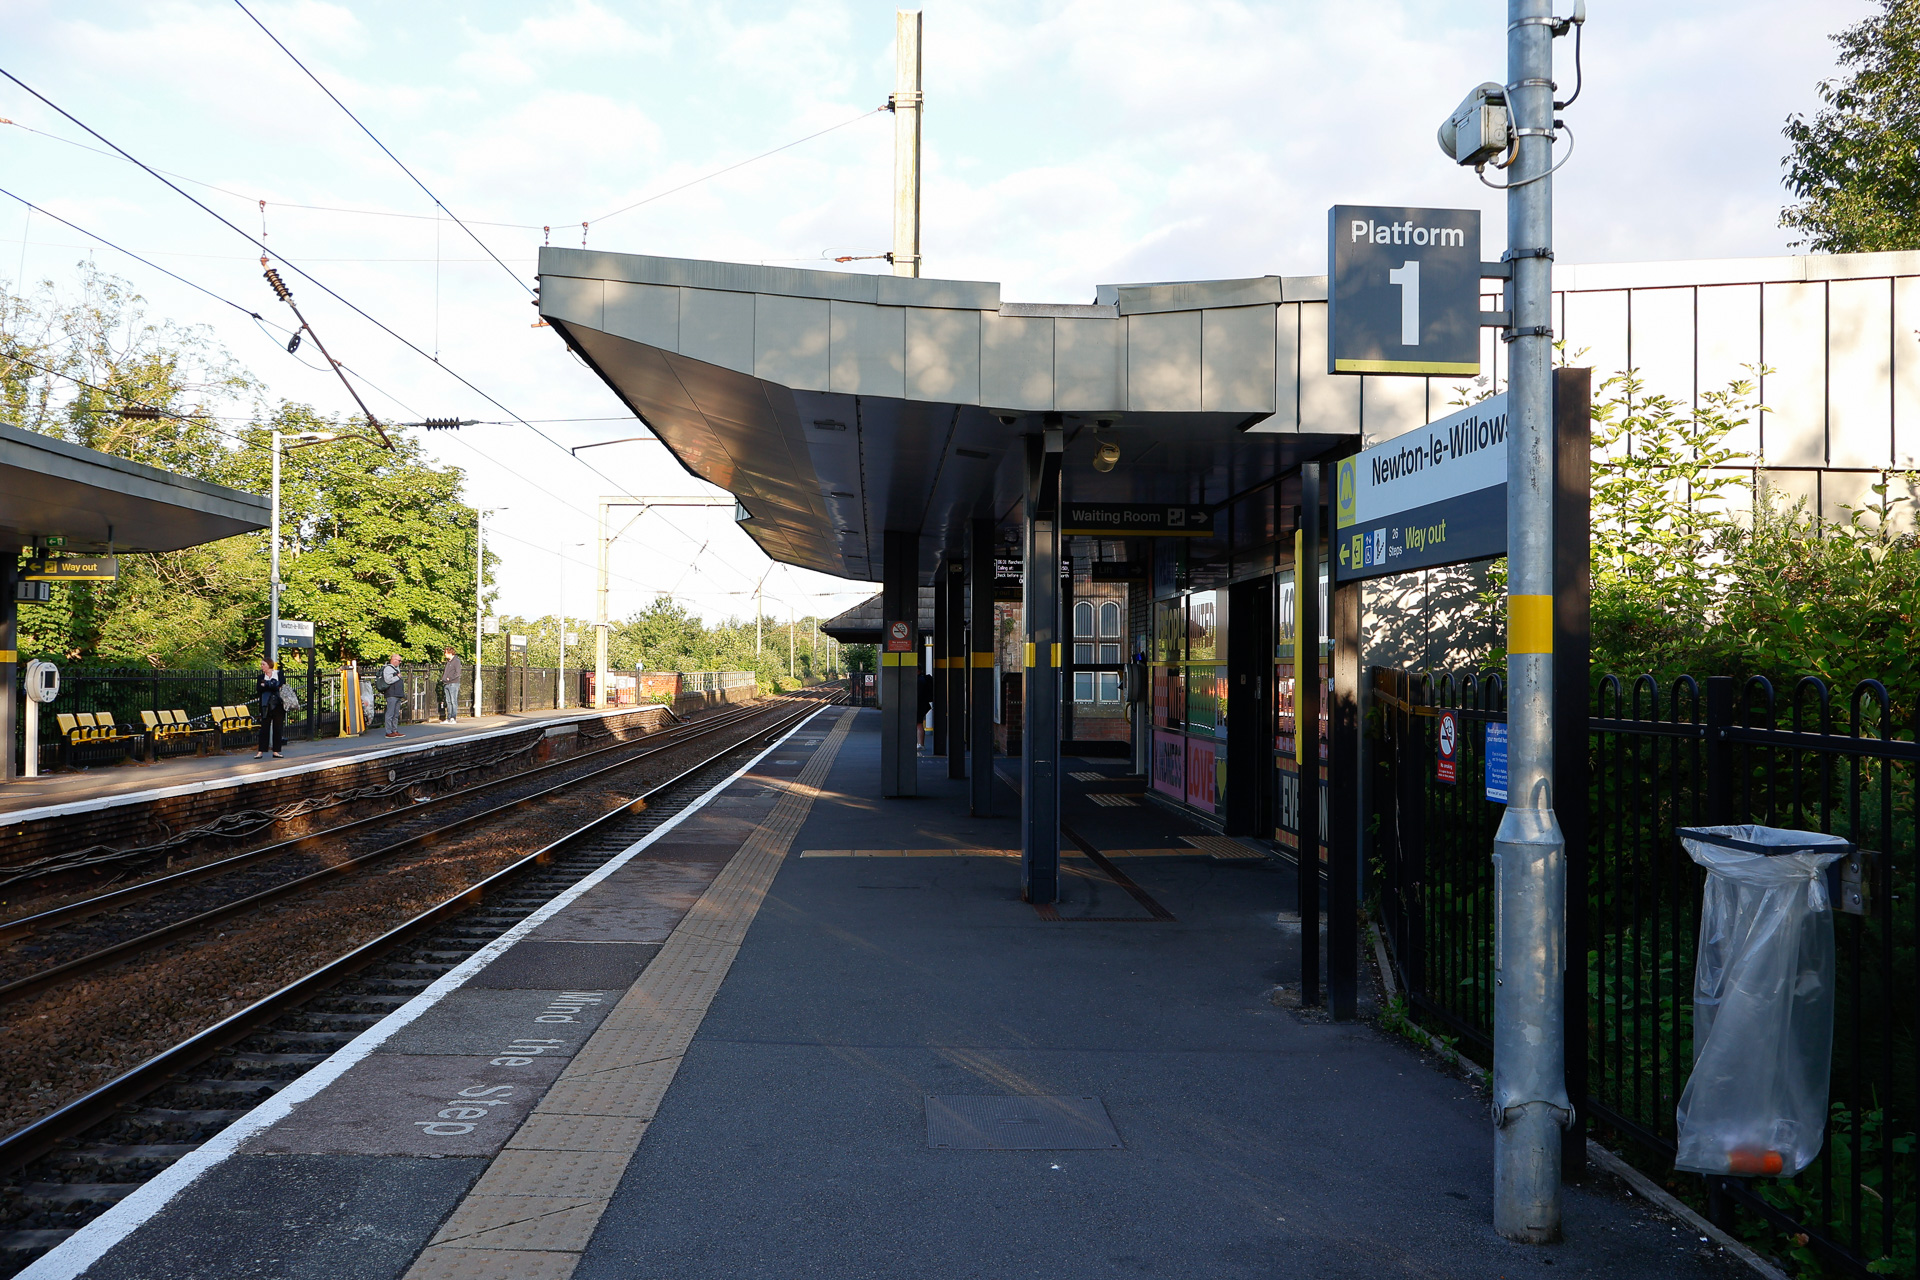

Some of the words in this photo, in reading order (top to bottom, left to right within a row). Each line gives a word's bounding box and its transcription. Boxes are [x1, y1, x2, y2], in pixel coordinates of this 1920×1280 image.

[1352, 220, 1464, 247] Platform
[1389, 260, 1420, 346] 1
[1072, 510, 1120, 524] Waiting
[1123, 511, 1161, 523] Room
[1391, 527, 1399, 540] 26
[1405, 526, 1427, 552] Way
[1428, 518, 1446, 545] out
[1388, 545, 1403, 558] Steps
[61, 563, 80, 573] Way
[81, 563, 98, 571] out
[487, 621, 495, 631] 2
[1188, 746, 1214, 803] LOVE
[534, 991, 603, 1024] Mind
[490, 1038, 565, 1067] the
[413, 1084, 514, 1136] Step
